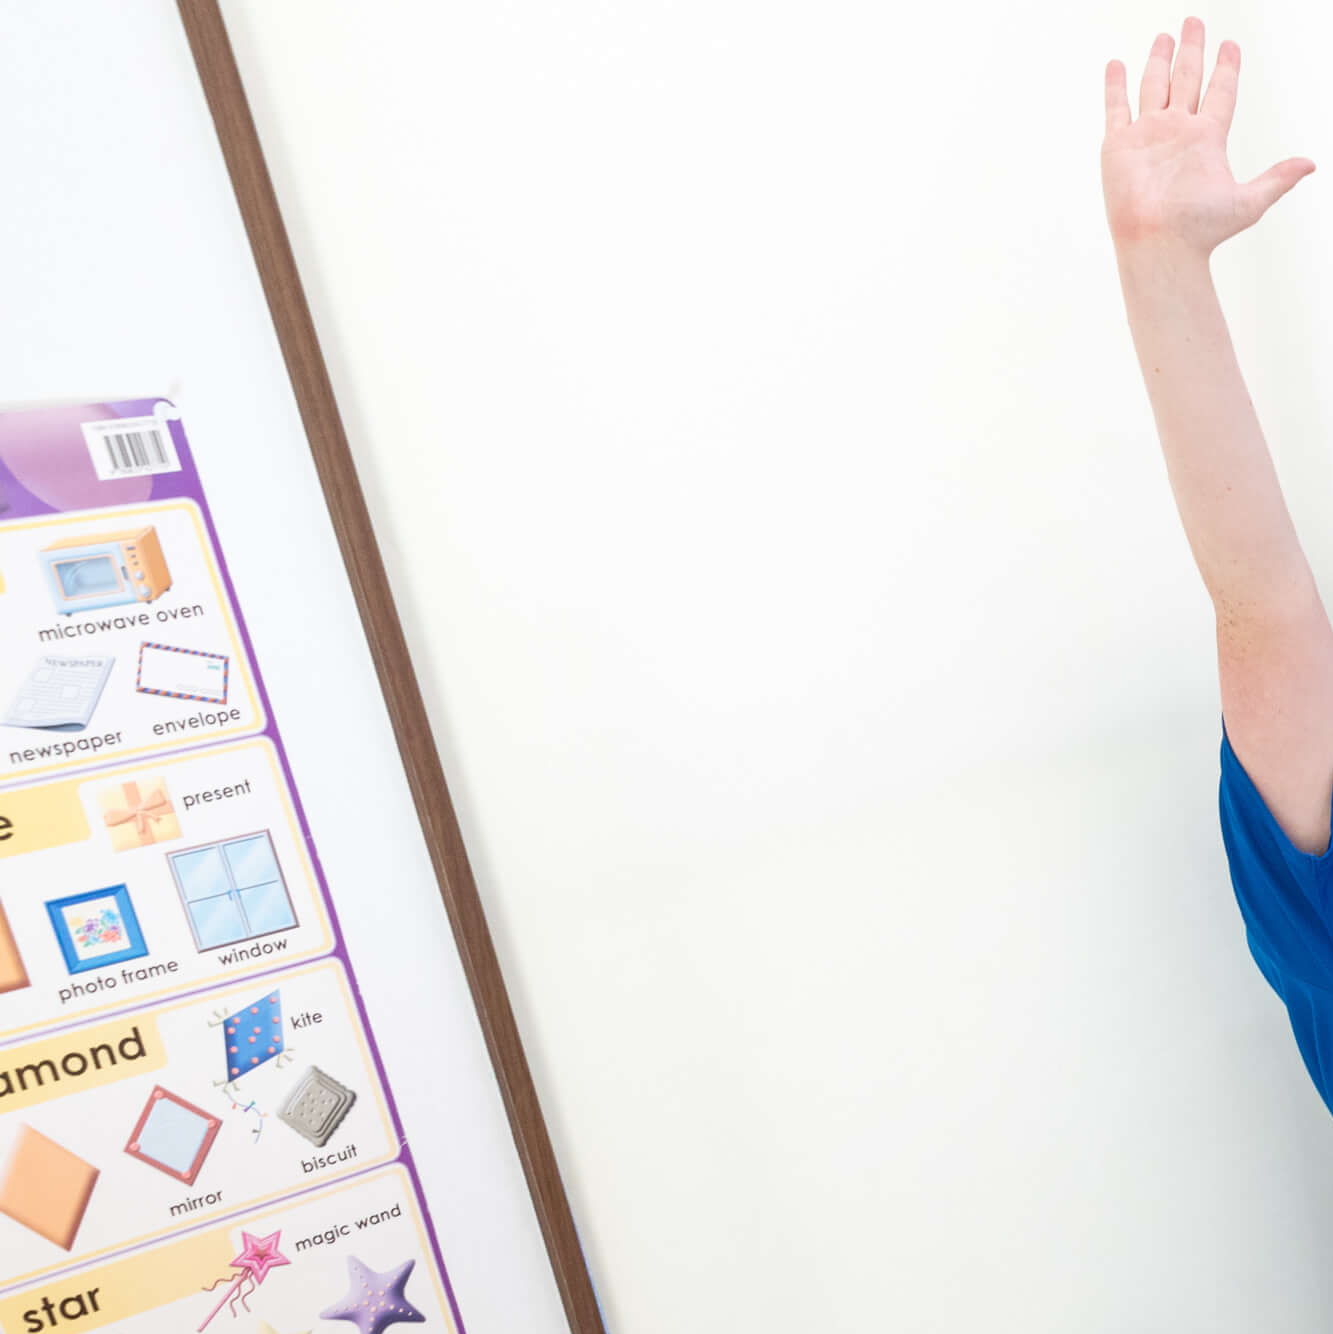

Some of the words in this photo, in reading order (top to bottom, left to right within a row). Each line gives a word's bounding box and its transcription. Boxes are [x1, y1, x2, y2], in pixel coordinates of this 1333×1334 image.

[38, 609, 150, 643] microwave
[156, 603, 204, 623] oven
[153, 705, 241, 736] envelope
[9, 729, 124, 764] newspaper
[182, 779, 251, 811] present
[217, 938, 289, 967] window
[58, 973, 118, 1004] photo
[121, 960, 179, 988] frame
[290, 1010, 324, 1031] kite
[300, 1144, 359, 1174] biscuit
[169, 1190, 224, 1218] mirror
[295, 1223, 351, 1253] magic
[354, 1204, 402, 1231] wand
[22, 1286, 102, 1334] star
